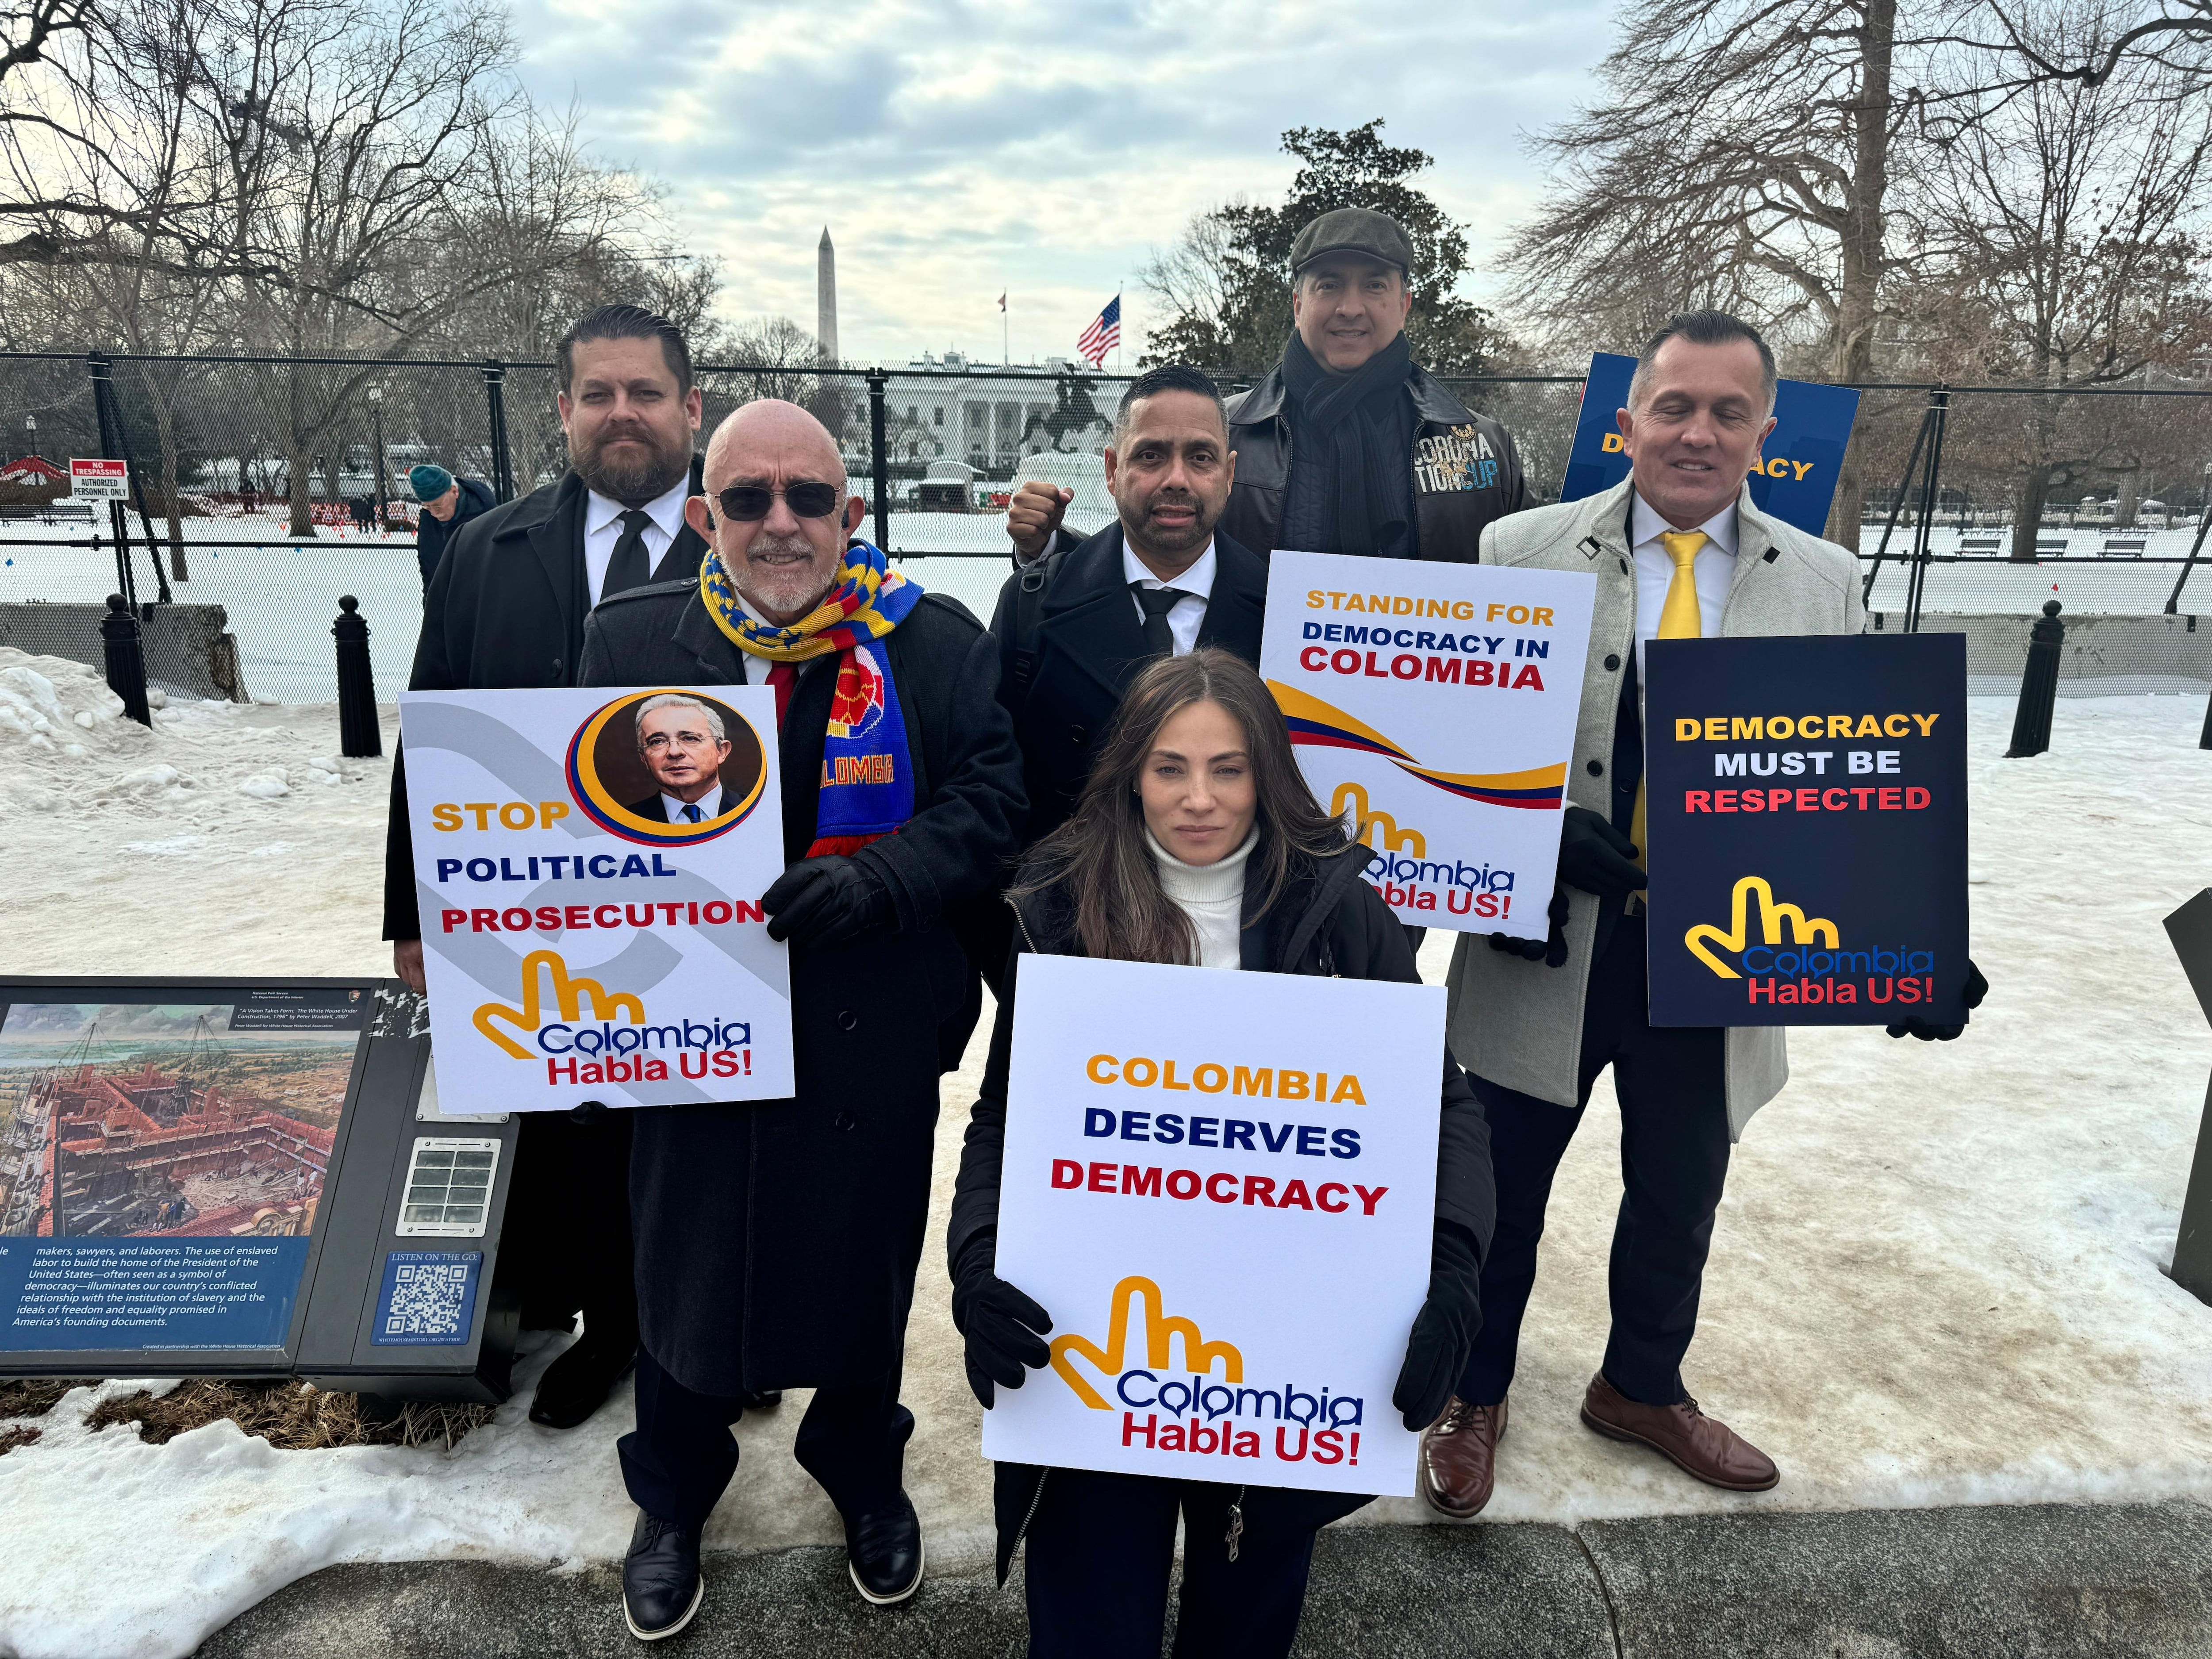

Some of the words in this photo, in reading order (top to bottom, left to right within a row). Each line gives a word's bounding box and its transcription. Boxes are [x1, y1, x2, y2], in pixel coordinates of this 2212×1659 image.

[1306, 589, 1475, 621] STANDING
[1486, 603, 1555, 627] FOR
[1302, 622, 1505, 655] DEMOCRACY
[1514, 638, 1550, 659] IN
[1300, 646, 1544, 691] COLOMBIA
[1674, 714, 1940, 742] DEMOCRACY
[820, 754, 894, 789] LOMBIA
[1714, 751, 1834, 777] MUST
[1847, 750, 1901, 775] BE
[432, 801, 570, 833] STOP
[1685, 786, 1932, 814] RESPECTED
[437, 853, 677, 883] POLITICAL
[1364, 852, 1515, 894] olombia
[442, 899, 765, 933] PROSECUTION
[1371, 881, 1436, 911] bla
[1448, 889, 1511, 920] US!
[1741, 945, 1934, 979] Colombia
[1748, 977, 1857, 1004] Habla
[1867, 977, 1933, 1004] US!
[537, 1017, 751, 1059] Colombia
[547, 1054, 668, 1086] Habla
[679, 1049, 751, 1079] US!
[1086, 1053, 1367, 1106] COLOMBIA
[1083, 1107, 1361, 1160] DESERVES
[1051, 1159, 1389, 1216] DEMOCRACY
[32, 1258, 59, 1267] labor
[73, 1258, 100, 1267] build
[102, 1258, 118, 1267] the
[120, 1258, 148, 1267] home
[230, 1258, 241, 1266] of
[243, 1258, 258, 1266] the
[36, 1247, 73, 1256] makers,
[76, 1248, 115, 1257] sawyers,
[223, 1246, 235, 1255] of
[236, 1246, 278, 1255] enslaved
[29, 1270, 63, 1278] United
[178, 1270, 213, 1280] symbol
[215, 1269, 227, 1278] of
[209, 1281, 257, 1290] conflicted
[16, 1305, 45, 1314] ideals
[48, 1305, 60, 1313] of
[61, 1305, 103, 1313] freedom
[106, 1305, 126, 1313] and
[127, 1305, 168, 1316] equality
[169, 1305, 215, 1316] promised
[218, 1305, 227, 1313] in
[20, 1293, 79, 1304] relationship
[82, 1293, 104, 1302] with
[107, 1293, 123, 1302] the
[179, 1293, 191, 1302] of
[191, 1293, 226, 1304] slavery
[227, 1293, 247, 1302] and
[249, 1293, 265, 1302] the
[64, 1317, 109, 1328] founding
[111, 1317, 167, 1326] documents.
[1116, 1369, 1363, 1430] Colombia
[1122, 1411, 1260, 1459] Habla
[1275, 1426, 1360, 1466] US!
